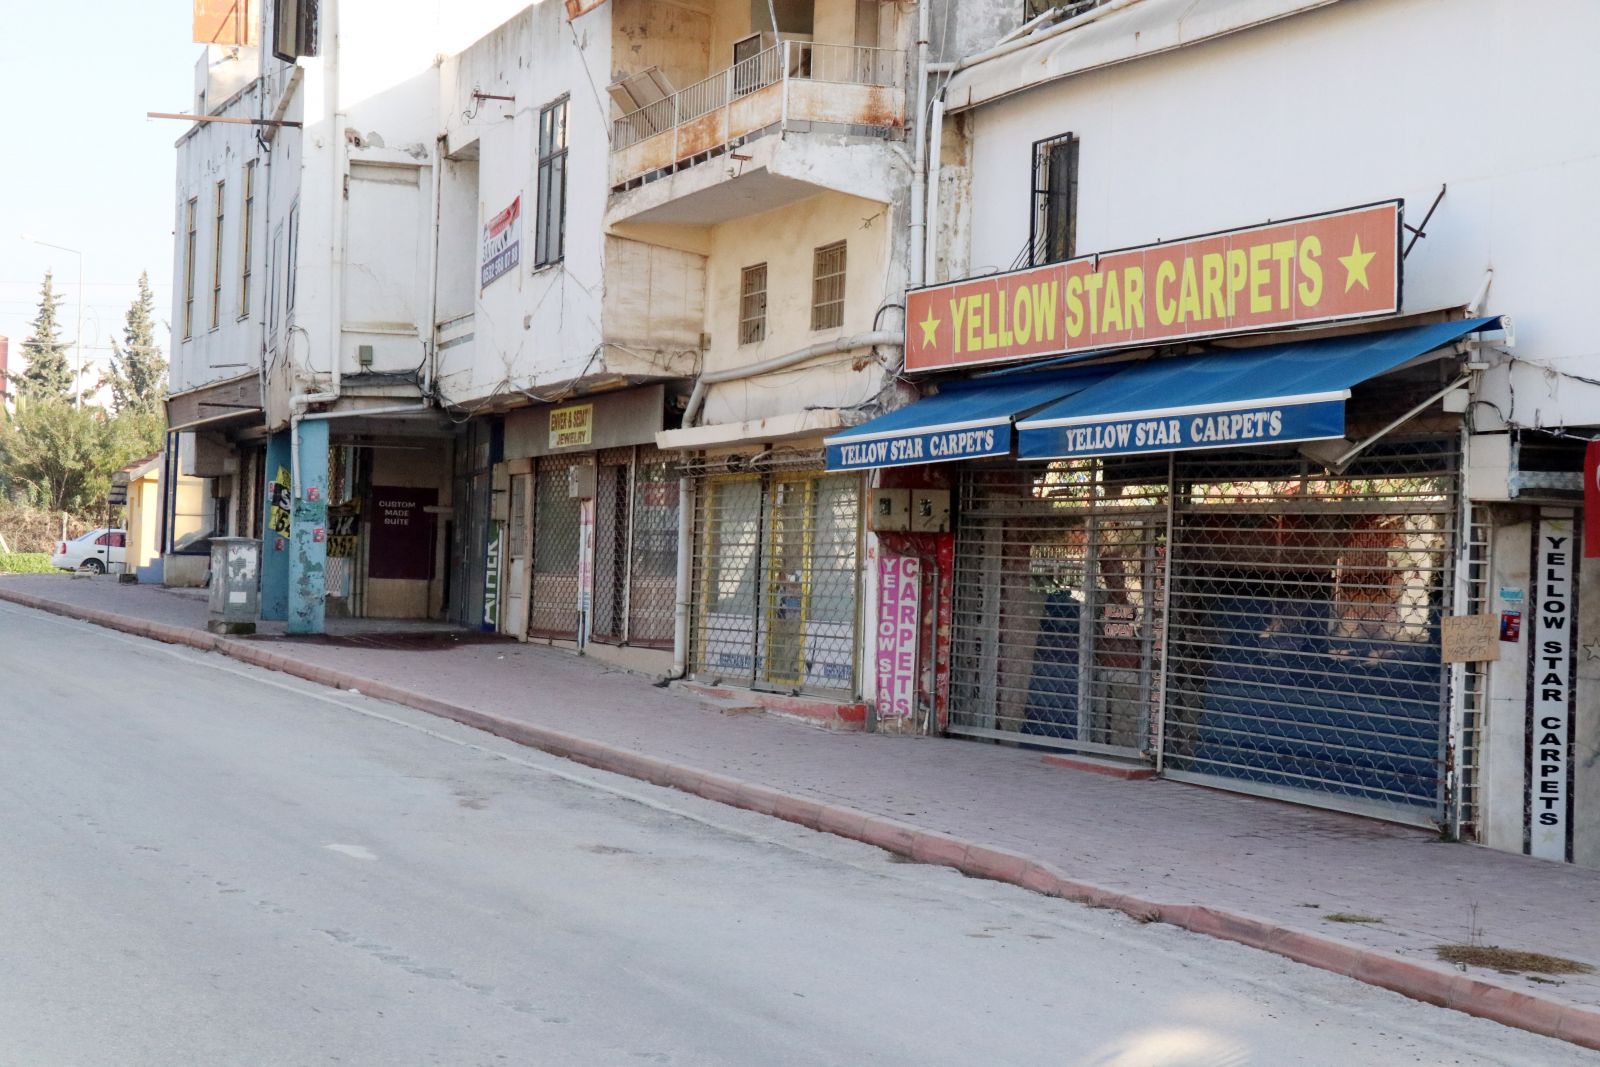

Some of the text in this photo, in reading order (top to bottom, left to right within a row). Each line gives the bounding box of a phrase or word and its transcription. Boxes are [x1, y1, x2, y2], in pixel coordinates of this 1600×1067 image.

[950, 235, 1323, 353] YELLOW STAR CARPETS
[557, 430, 586, 445] JEWELRY
[1066, 410, 1282, 451] YELLOW STAR CARPET'S
[841, 442, 888, 465] YELLOW
[890, 437, 923, 461] STAR
[379, 500, 416, 508] CUSTOM
[384, 509, 409, 517] MADE
[384, 518, 409, 526] SUITE
[879, 558, 897, 713] YELLOW STAR
[896, 558, 918, 717] CARPETS
[1539, 536, 1568, 826] YELLOW STAR CARPETS
